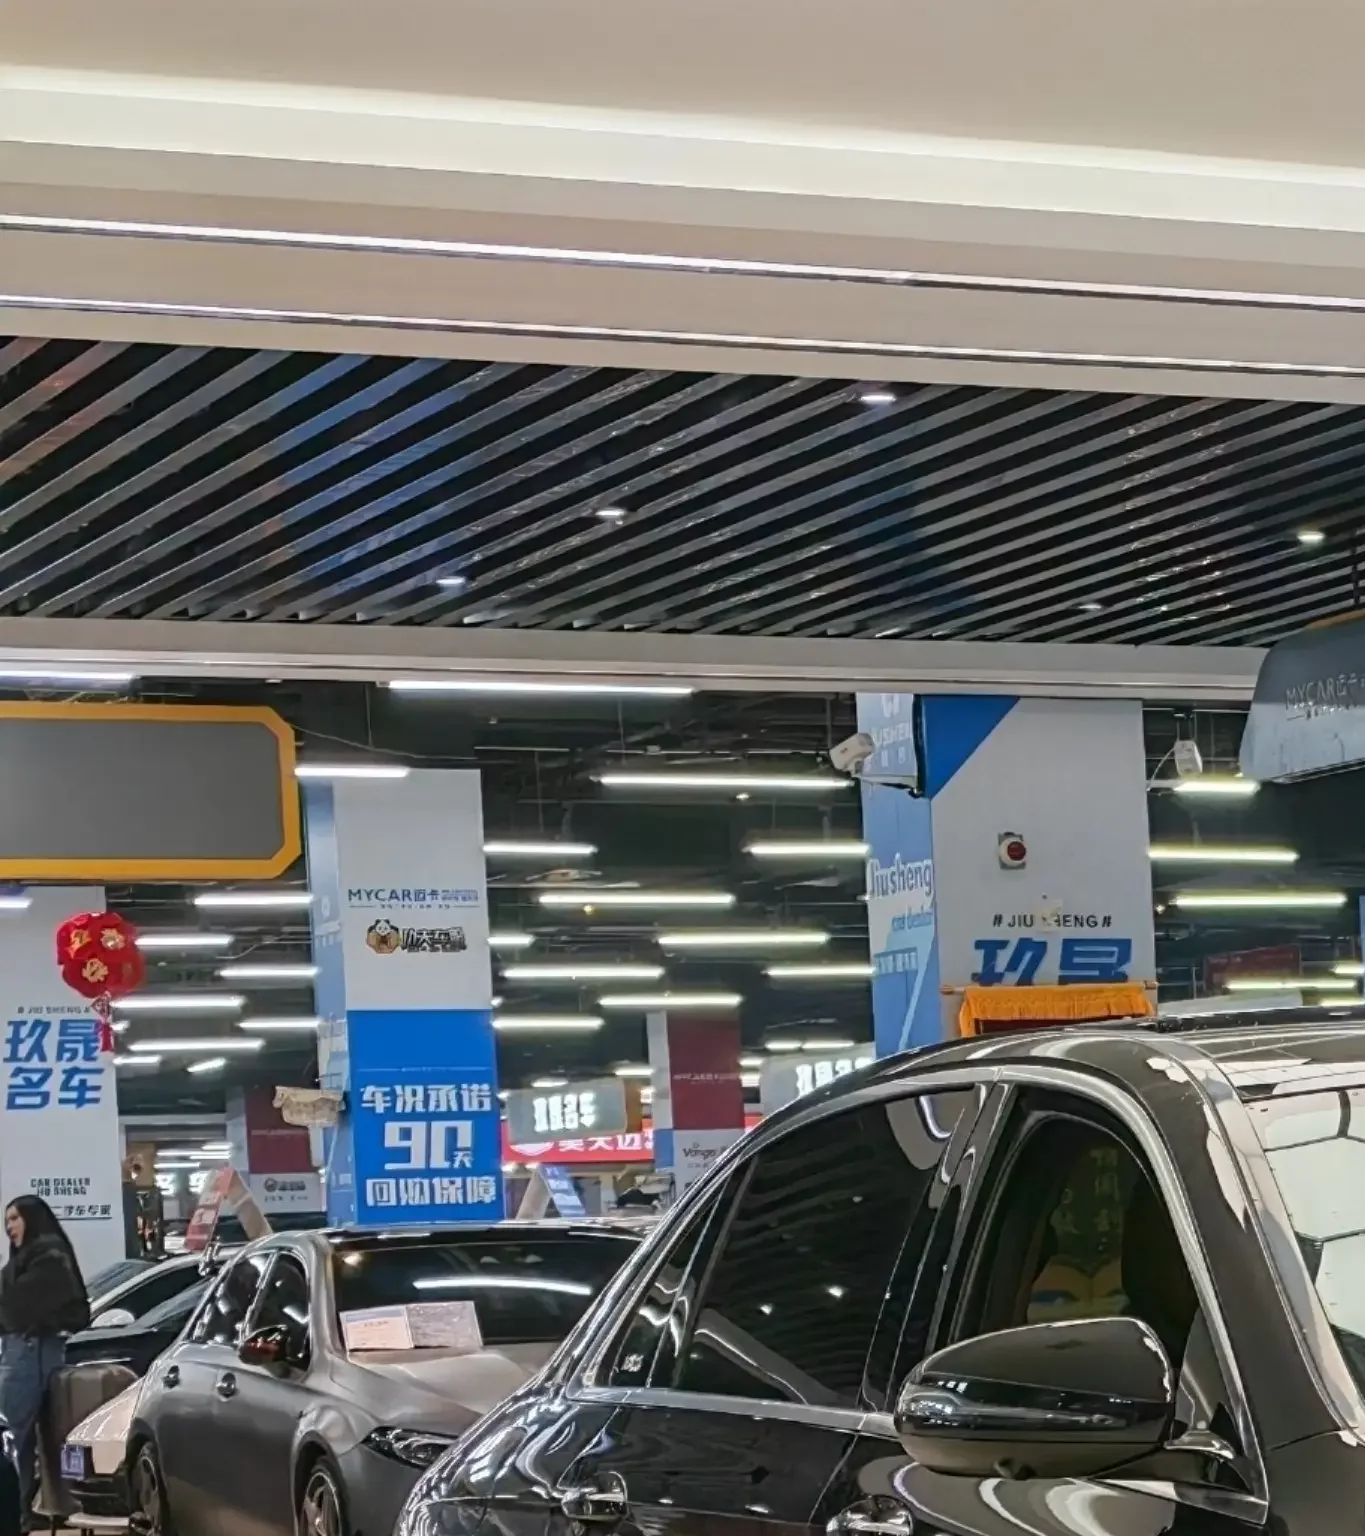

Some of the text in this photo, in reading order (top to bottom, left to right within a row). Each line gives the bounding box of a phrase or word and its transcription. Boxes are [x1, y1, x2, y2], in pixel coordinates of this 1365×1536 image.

[1008, 914, 1034, 928] JIU
[1041, 914, 1098, 928] HENG
[6, 1066, 104, 1110] 名车
[360, 1083, 492, 1114] 车况承诺
